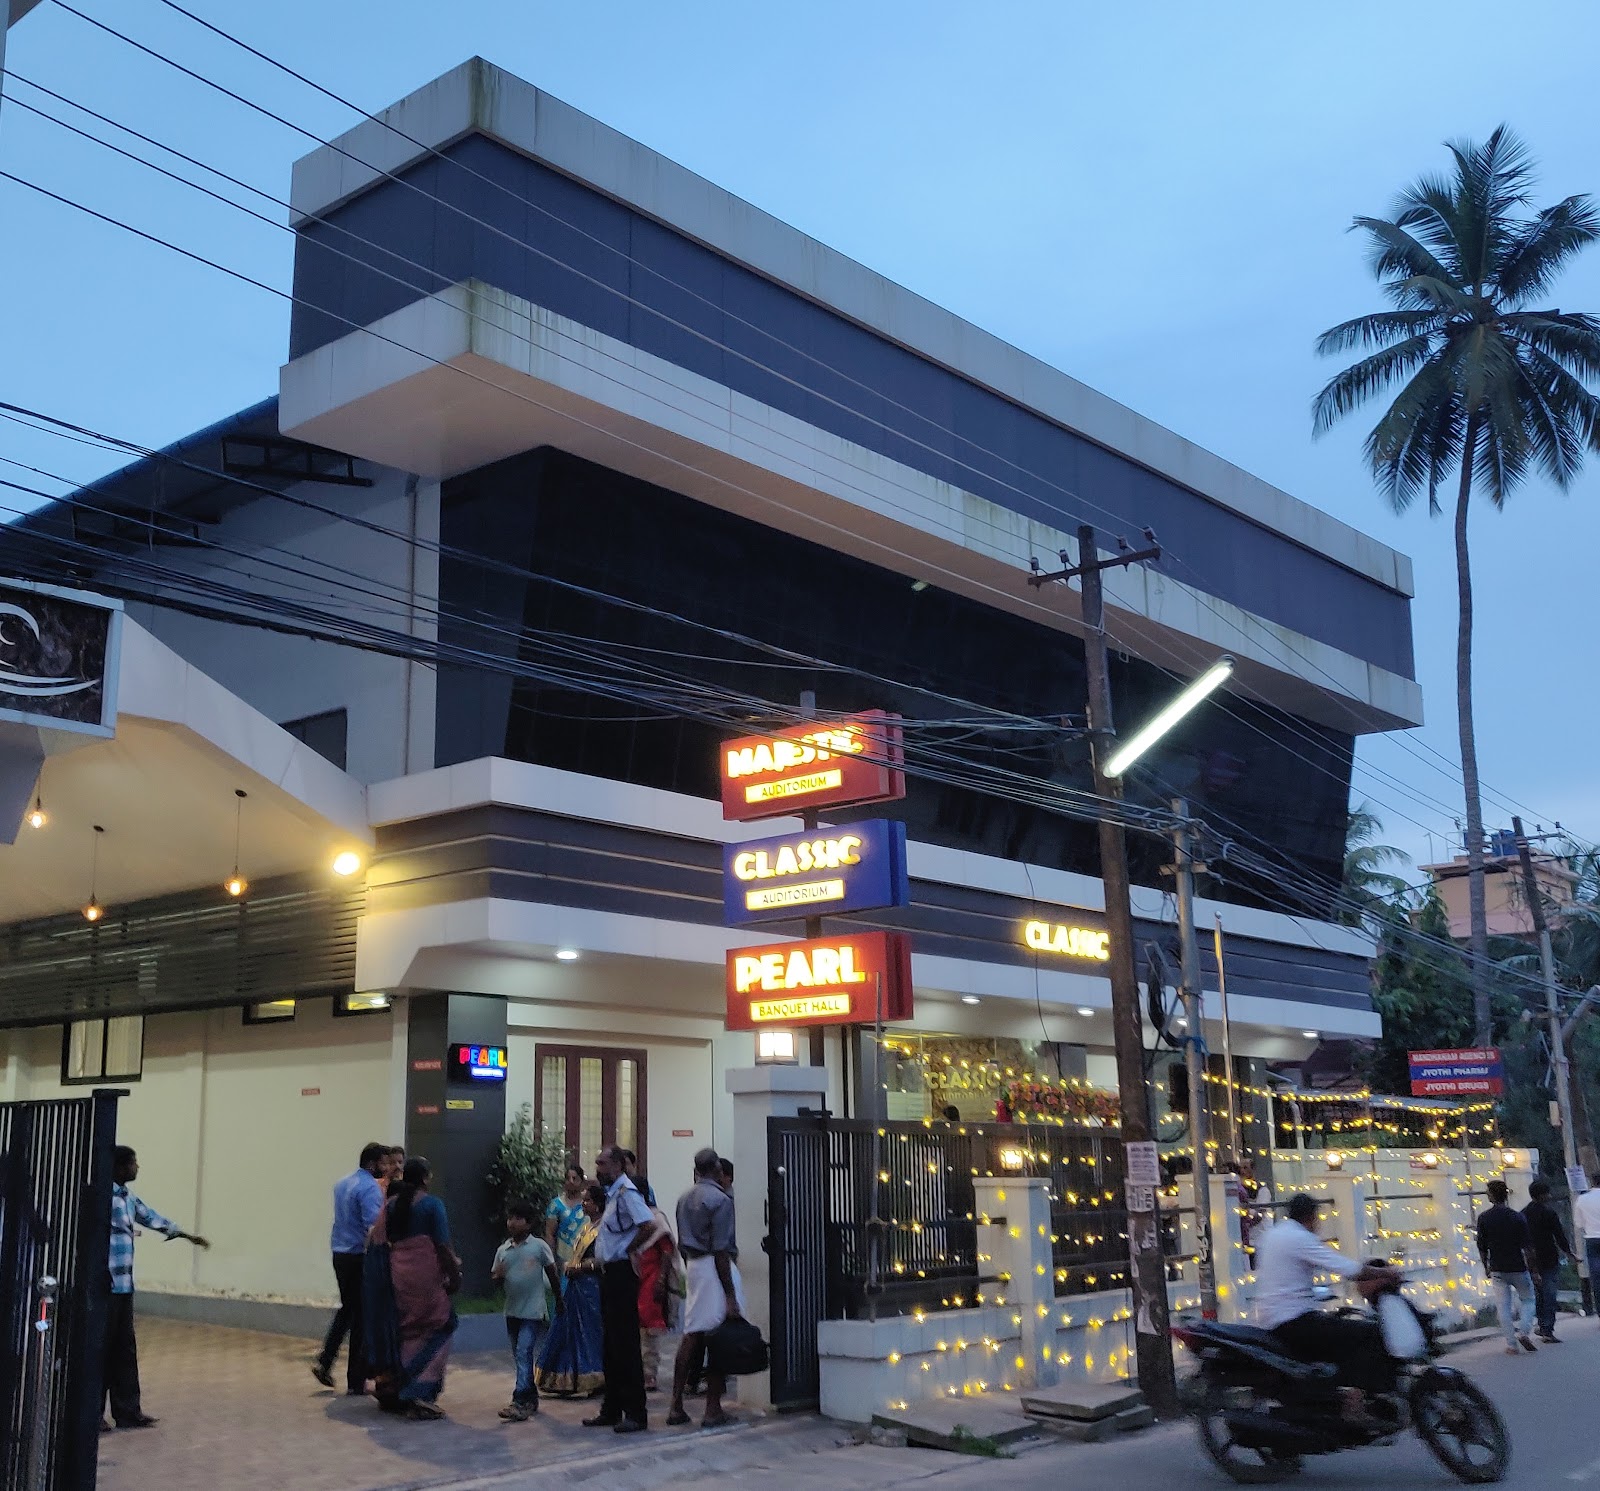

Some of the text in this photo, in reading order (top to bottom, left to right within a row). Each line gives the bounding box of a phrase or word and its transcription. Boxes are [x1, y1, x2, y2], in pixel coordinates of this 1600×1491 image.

[727, 726, 865, 778] MAJESTIC
[761, 776, 828, 797] AUDITORIUM
[734, 835, 862, 880] CLASSIC
[762, 885, 829, 904] AUDITORIUM
[1024, 920, 1110, 960] CLASSIC
[735, 946, 866, 993] PEARL
[759, 1001, 841, 1018] BANQUET HALL
[459, 1046, 507, 1067] PEARL
[926, 1071, 1002, 1090] CLASSIC
[1421, 1068, 1452, 1077] JYOTHI
[1425, 1083, 1456, 1092] JYOTHI
